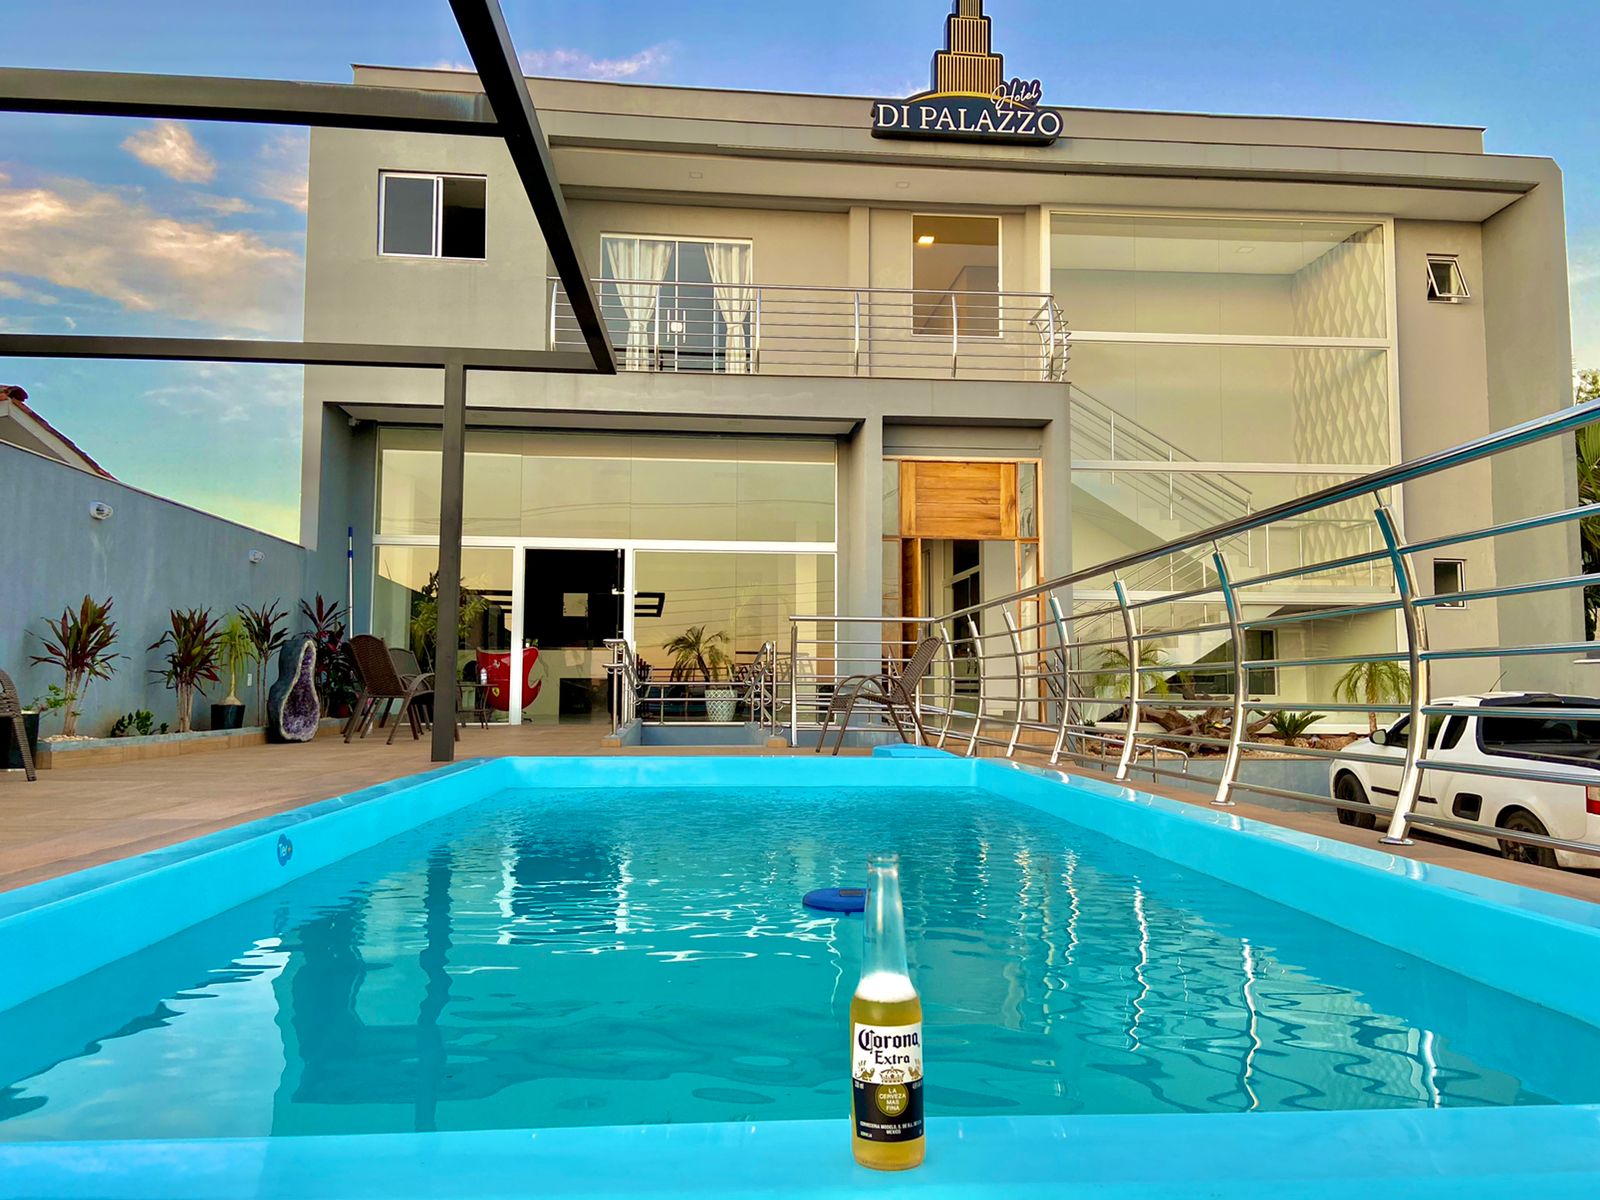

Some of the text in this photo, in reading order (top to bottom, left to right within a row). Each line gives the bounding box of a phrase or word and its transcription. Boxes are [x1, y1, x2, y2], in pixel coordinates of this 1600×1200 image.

[990, 82, 1039, 110] Hotel
[876, 103, 1061, 136] DI PALAZZO
[858, 1029, 920, 1054] Corona
[875, 1050, 910, 1065] Extra
